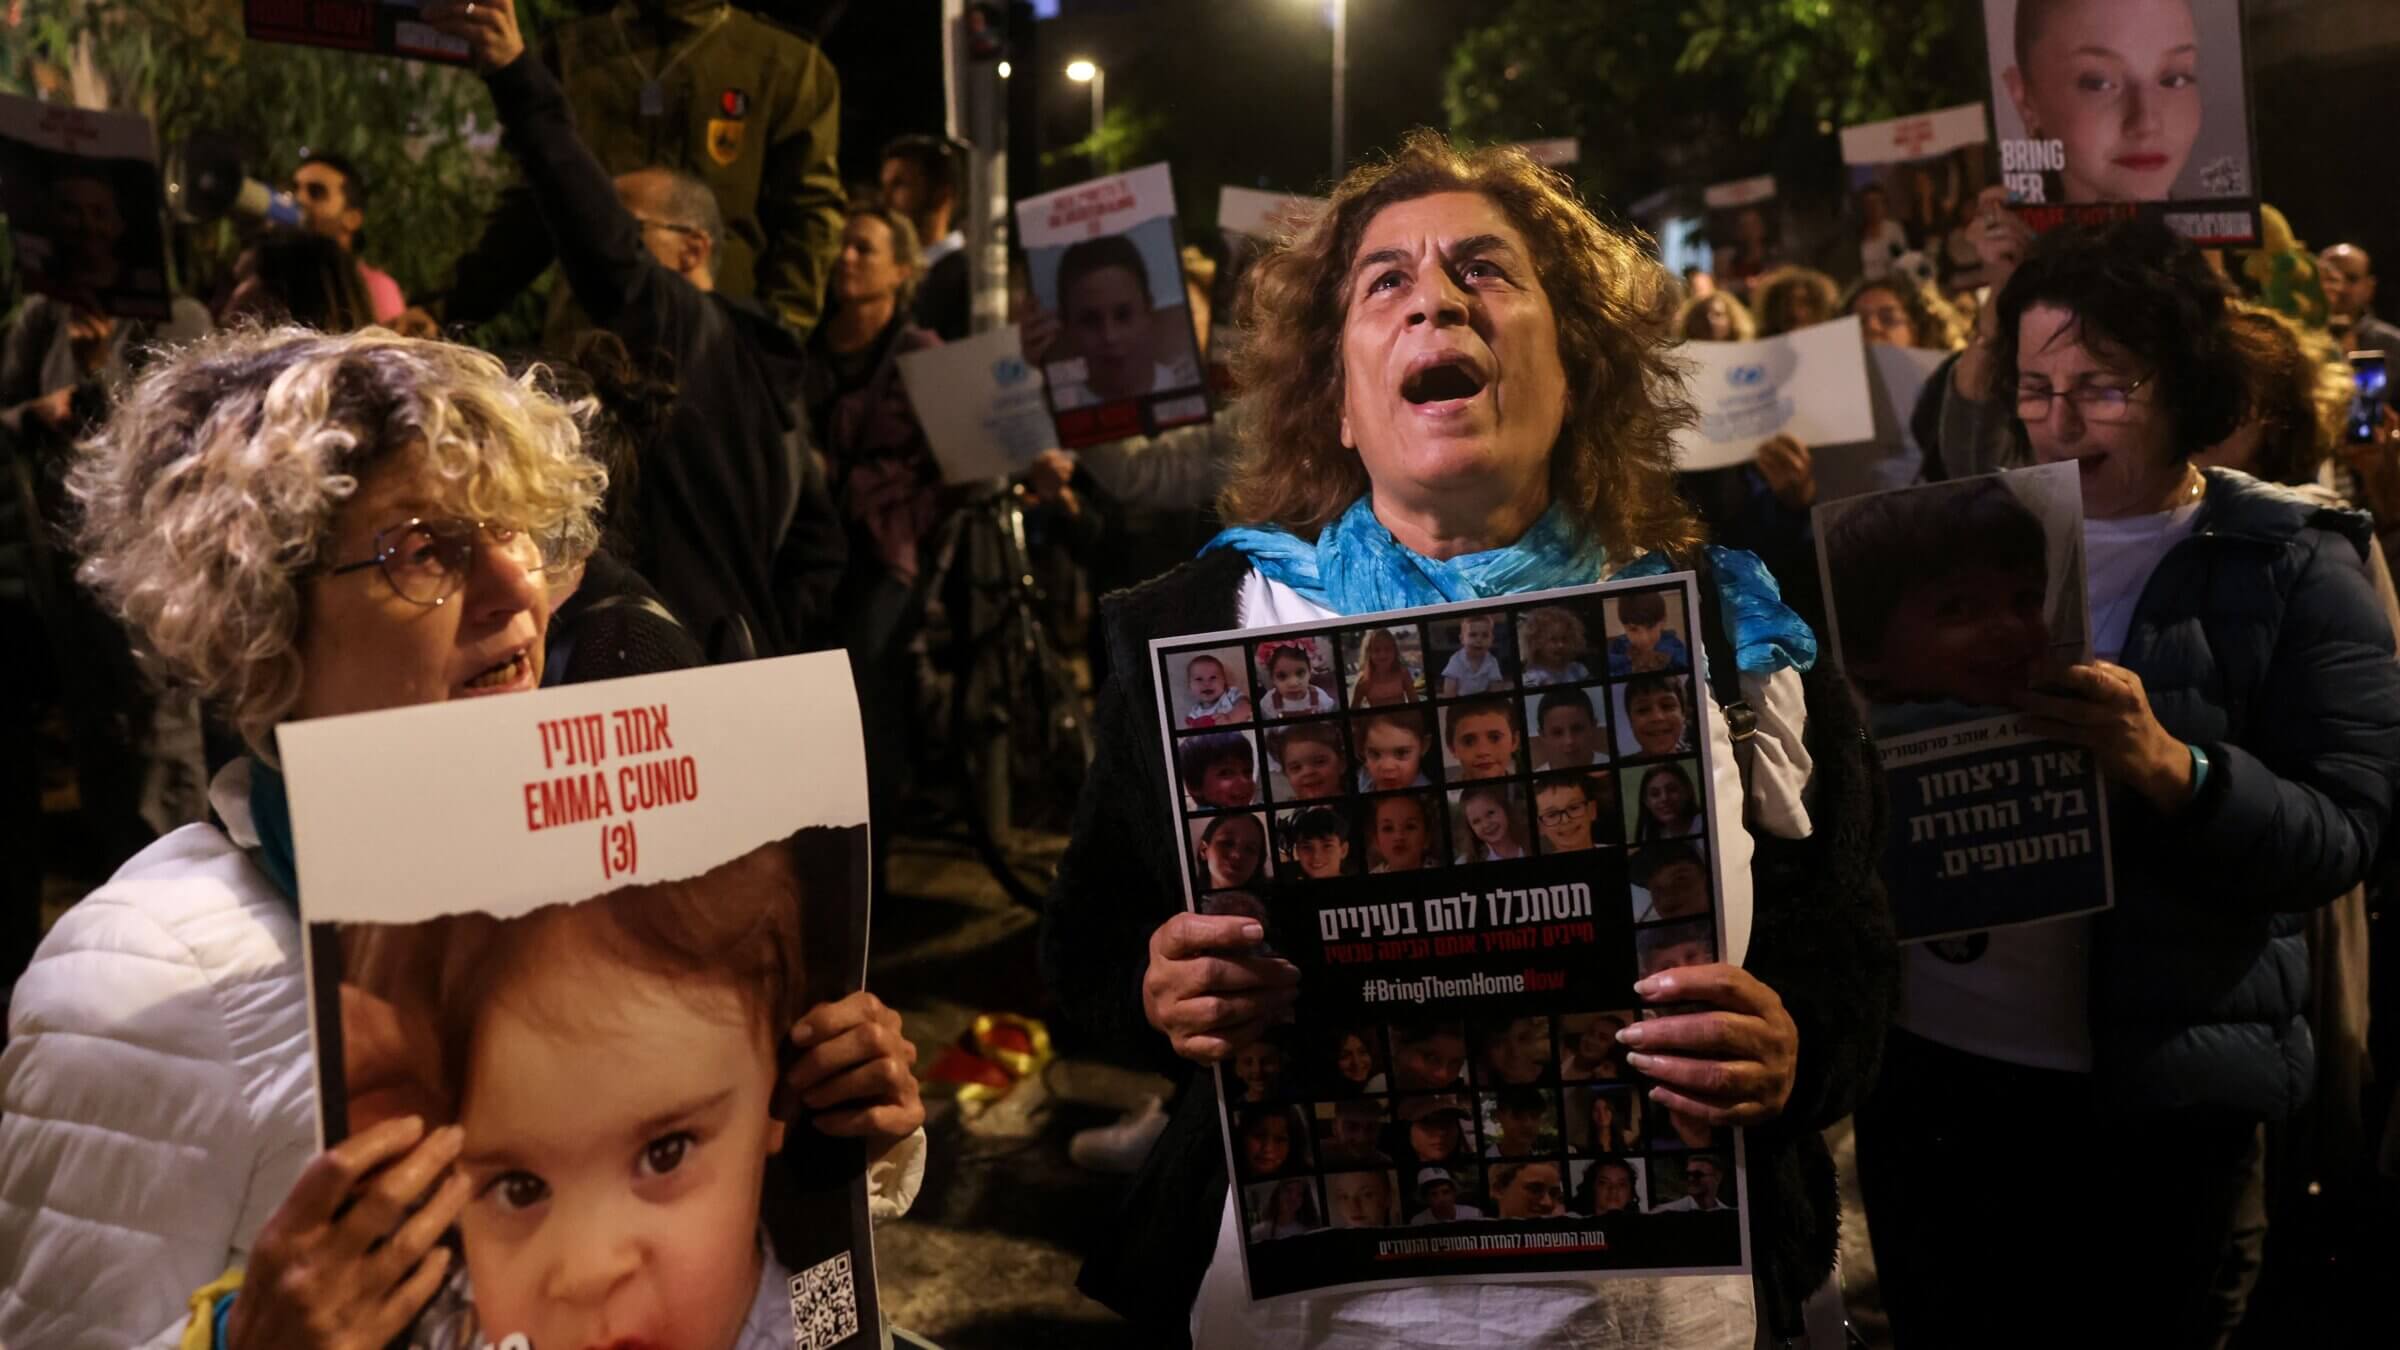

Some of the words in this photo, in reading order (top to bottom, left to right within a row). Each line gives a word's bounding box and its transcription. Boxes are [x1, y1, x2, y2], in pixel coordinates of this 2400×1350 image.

[2001, 139, 2066, 172] BRING
[2003, 173, 2047, 204] HER
[537, 713, 606, 769] קוניו
[612, 704, 674, 757] אמה
[1917, 759, 2021, 807] ניצחון
[2032, 750, 2084, 788] אין
[524, 771, 613, 832] EMMA
[619, 756, 698, 813] CUNIO
[2030, 787, 2089, 820] בלי
[1909, 799, 2022, 843] החזרת
[602, 820, 638, 880] (3)
[1937, 828, 2092, 880] החטופים.
[1318, 901, 1418, 941] בעיניים
[1423, 891, 1478, 933] להם
[1485, 881, 1592, 927] תסתכלו
[1479, 1233, 1521, 1251] להחזרת
[1524, 1231, 1578, 1249] המשפחות
[1580, 1230, 1605, 1247] מטה
